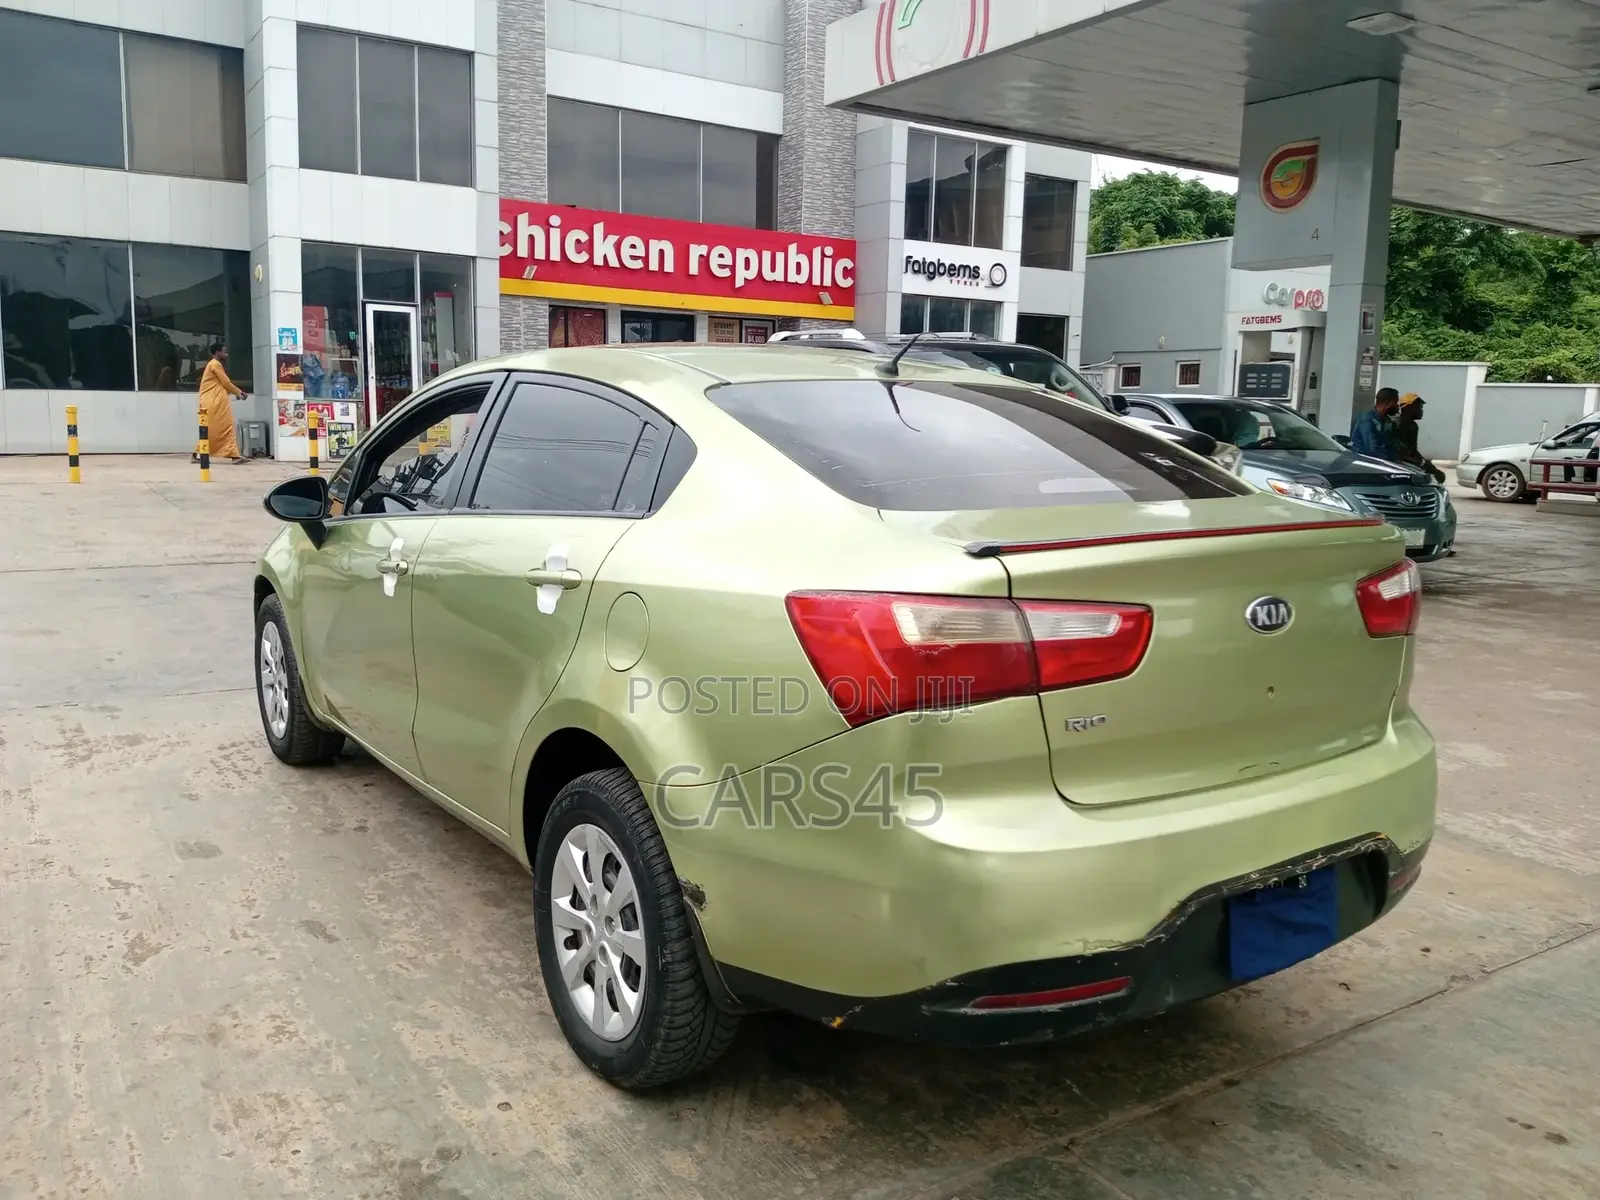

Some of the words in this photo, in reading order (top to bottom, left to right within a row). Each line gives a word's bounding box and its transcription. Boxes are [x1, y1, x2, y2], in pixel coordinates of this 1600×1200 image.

[1311, 227, 1320, 241] 4
[687, 241, 855, 289] republic
[1241, 315, 1283, 325] FATGBEMS
[1255, 603, 1289, 627] KIA
[1065, 714, 1108, 732] RIO
